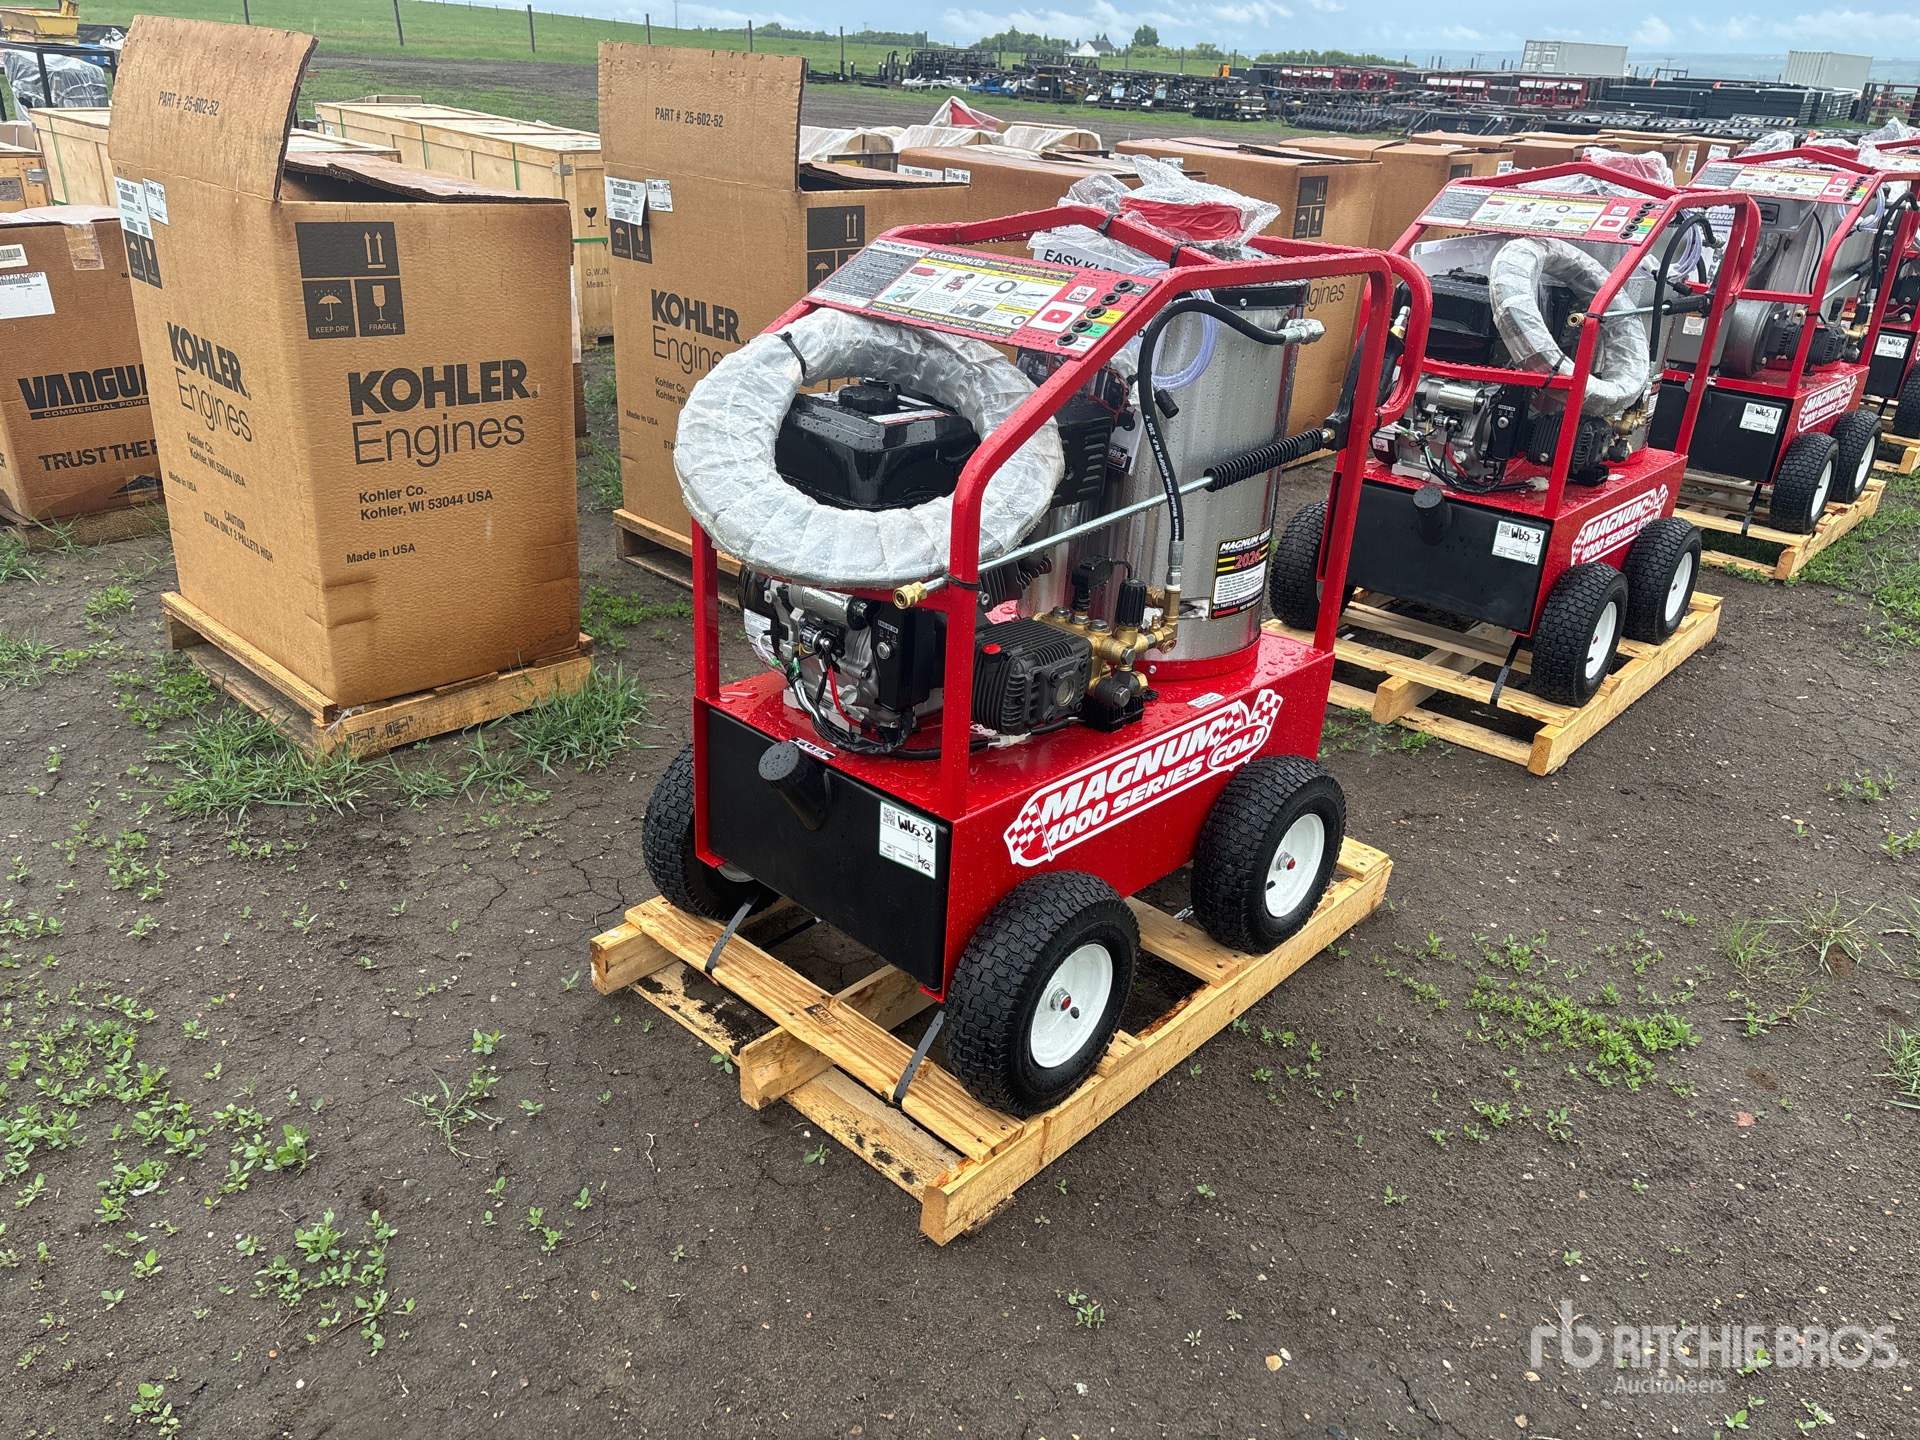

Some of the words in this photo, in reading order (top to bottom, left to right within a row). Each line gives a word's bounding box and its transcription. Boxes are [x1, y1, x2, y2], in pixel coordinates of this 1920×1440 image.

[158, 91, 176, 107] PART
[176, 95, 182, 109] #
[184, 95, 219, 116] 25-602-52
[655, 107, 674, 121] PART
[676, 110, 681, 122] #
[685, 111, 723, 127] 25-602-52
[928, 251, 988, 267] ACCESSORIES
[1309, 282, 1345, 312] gines
[651, 288, 741, 344] KOHLER
[167, 321, 247, 397] KOHLER
[348, 359, 530, 416] KOHLER
[655, 376, 675, 391] Kohler
[676, 383, 686, 394] Co.
[656, 389, 677, 404] Kohler,
[44, 402, 115, 418] COMMERCIAL
[175, 367, 252, 442] Engines
[626, 409, 640, 420] Made
[641, 414, 646, 422] in
[647, 415, 658, 427] USA
[187, 431, 205, 450] Kohler
[205, 442, 215, 455] Co.
[352, 413, 525, 467] Engines
[38, 446, 106, 471] TRUST
[109, 440, 150, 461] THE
[189, 447, 209, 468] Kohler,
[233, 472, 246, 488] USA
[168, 471, 181, 484] Made
[187, 480, 198, 493] USA
[359, 489, 402, 504] Kohler
[406, 485, 427, 497] Co.
[360, 505, 406, 521] Kohler,
[408, 501, 424, 512] WI
[428, 494, 463, 510] 53044
[467, 490, 493, 503] USA
[203, 511, 220, 529] STACK
[220, 521, 233, 538] ONLY
[238, 532, 259, 554] PALLETS
[224, 510, 246, 531] CAUTION
[1584, 500, 1645, 545] MAGNUM
[346, 551, 376, 564] Made
[380, 548, 389, 558] in
[392, 543, 416, 555] USA
[1220, 535, 1259, 551] MAGNUM
[1041, 719, 1223, 824] MAGNUM
[1043, 803, 1108, 848] 4000
[1110, 756, 1203, 816] SERIES
[1210, 730, 1263, 765] GOLD
